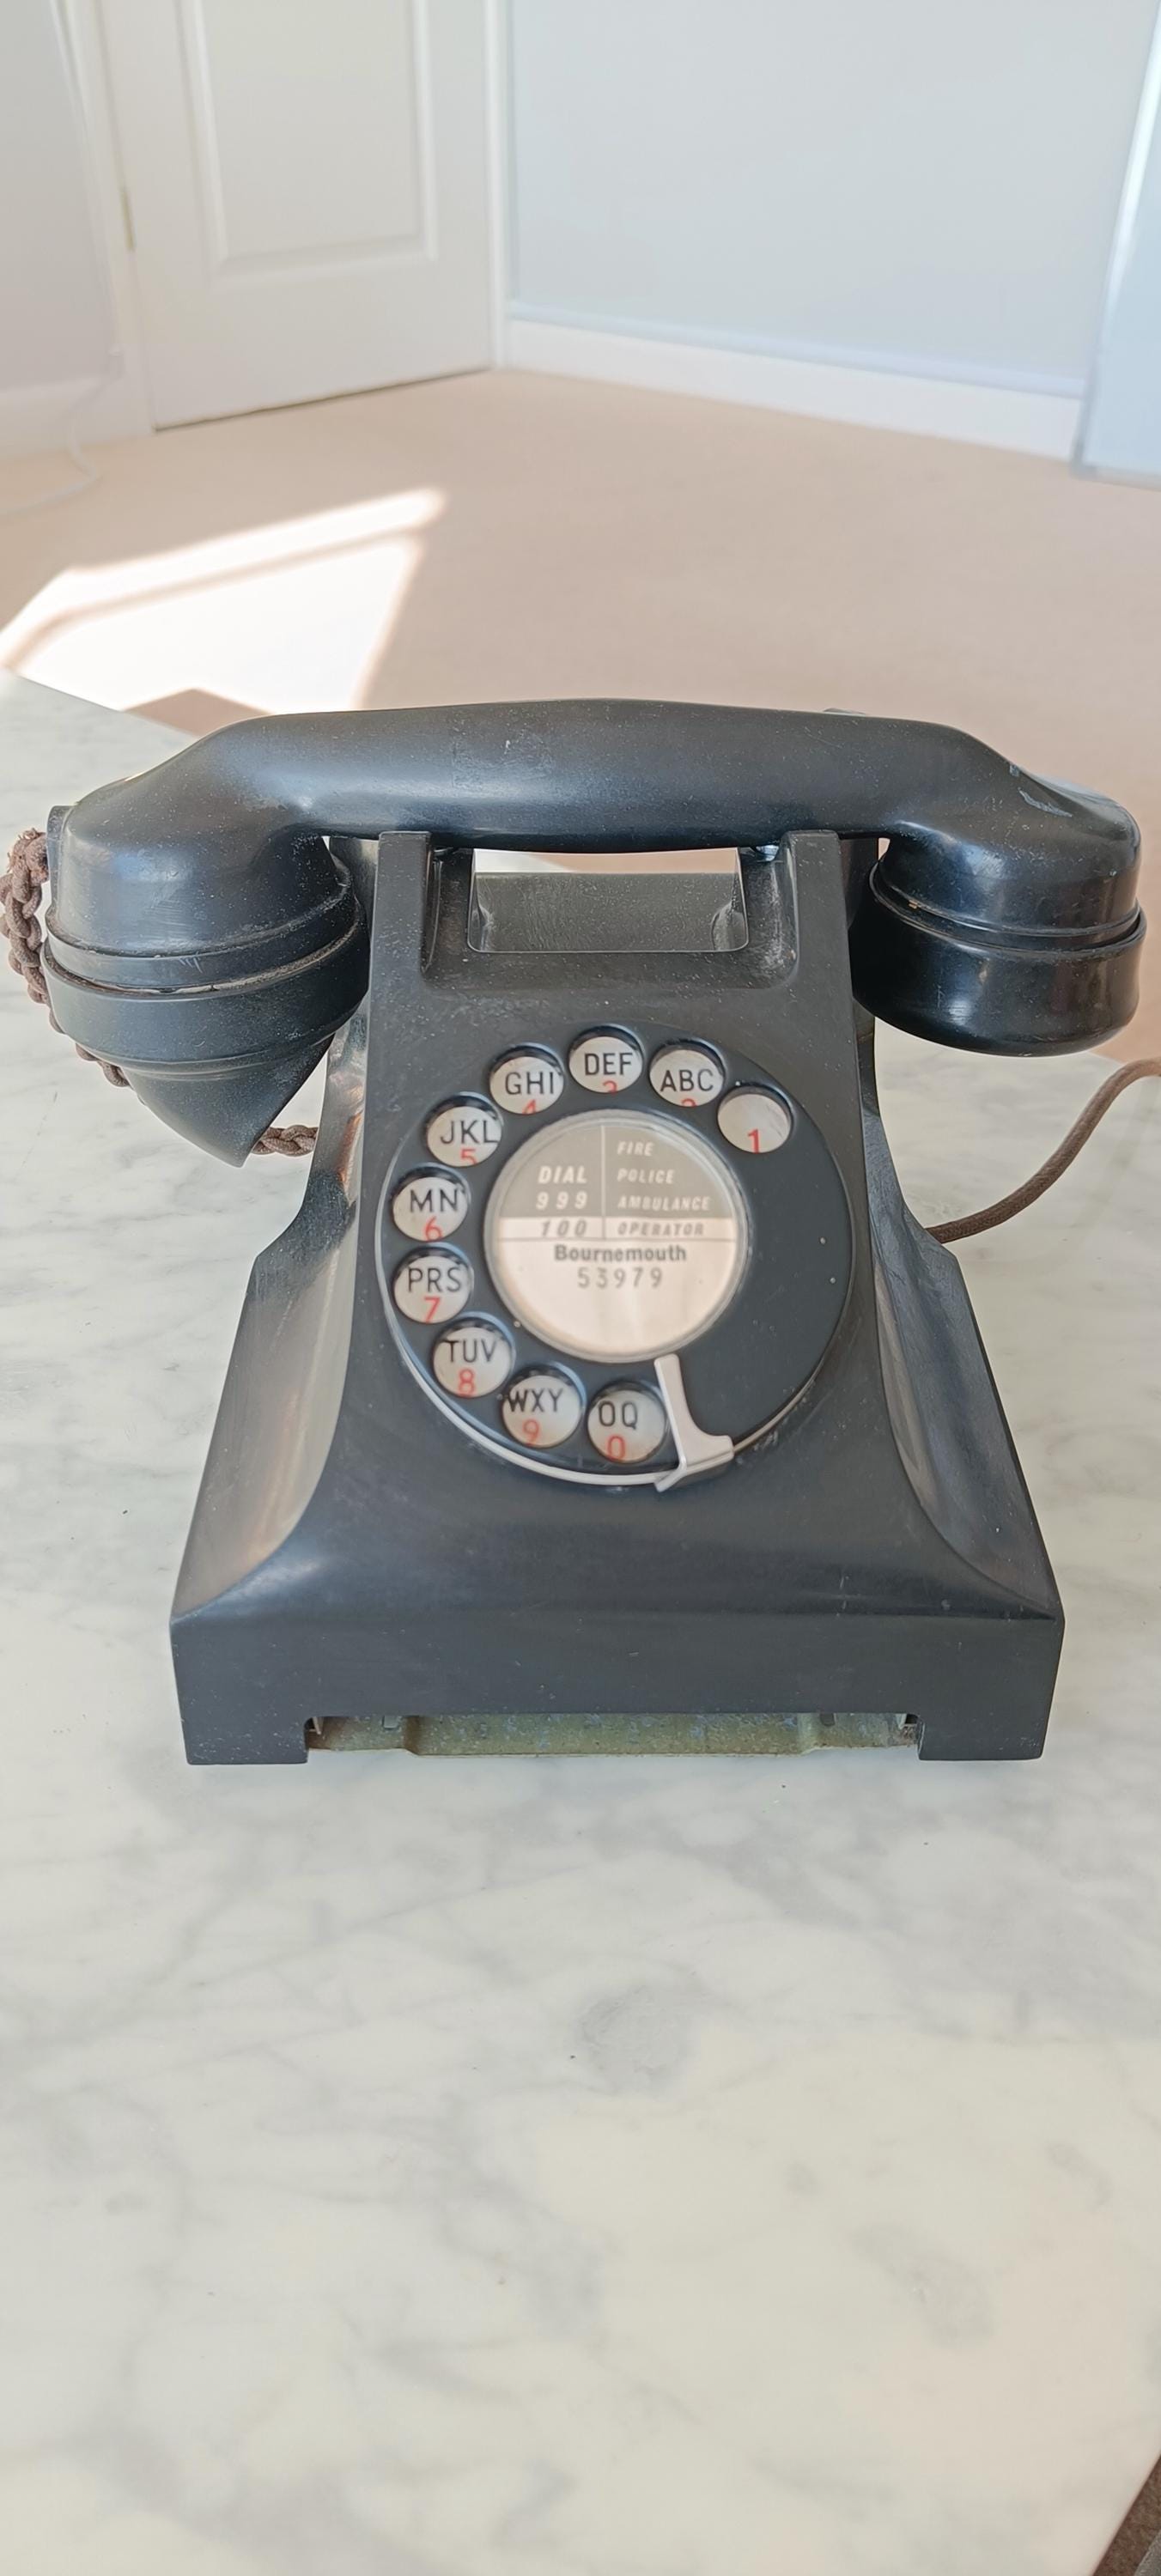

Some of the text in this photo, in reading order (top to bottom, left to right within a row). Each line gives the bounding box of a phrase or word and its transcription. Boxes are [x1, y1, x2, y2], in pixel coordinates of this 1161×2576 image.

[584, 1053, 633, 1076] DEF
[505, 1072, 555, 1096] GHI
[660, 1069, 714, 1092] ABC
[441, 1120, 499, 1145] JKL
[747, 1129, 761, 1153] 1
[617, 1141, 654, 1156] FIRE
[538, 1166, 588, 1184] DIAL
[617, 1169, 675, 1184] POLICE
[410, 1189, 459, 1213] MN
[617, 1196, 711, 1211] AMBULANCE
[424, 1217, 443, 1242] 6
[617, 1223, 704, 1236] OPERATOR
[554, 1244, 687, 1262] Bournemouth
[408, 1267, 463, 1292] PRS
[423, 1297, 441, 1323] 7
[446, 1339, 496, 1364] TUV
[458, 1369, 476, 1398] 8
[505, 1388, 562, 1413] WXY
[599, 1400, 638, 1430] OQ
[522, 1419, 539, 1446] 9
